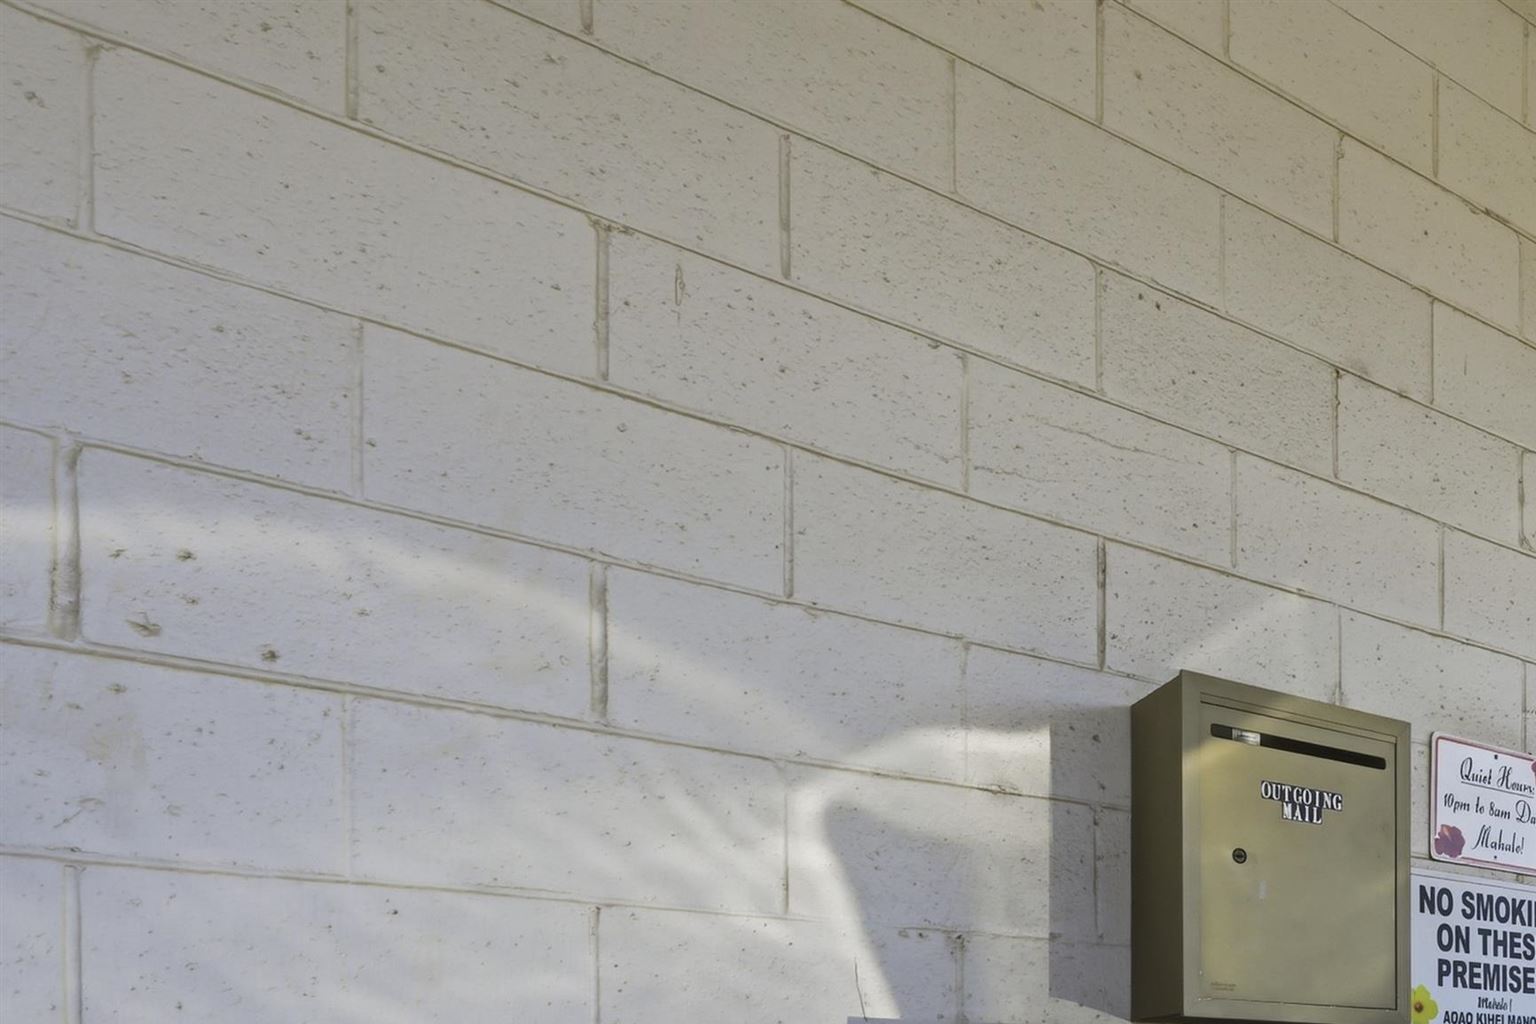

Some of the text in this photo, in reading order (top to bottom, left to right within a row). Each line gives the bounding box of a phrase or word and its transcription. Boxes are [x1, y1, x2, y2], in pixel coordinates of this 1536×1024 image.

[1460, 757, 1535, 795] Quiet Hours:
[1261, 781, 1342, 811] OUTGOING
[1444, 793, 1470, 813] 10pm
[1475, 796, 1485, 814] to
[1489, 801, 1511, 819] 8am
[1283, 802, 1322, 824] MAIL
[1472, 824, 1525, 855] Mahalo!
[1419, 884, 1454, 917] NO
[1437, 923, 1470, 954] ON
